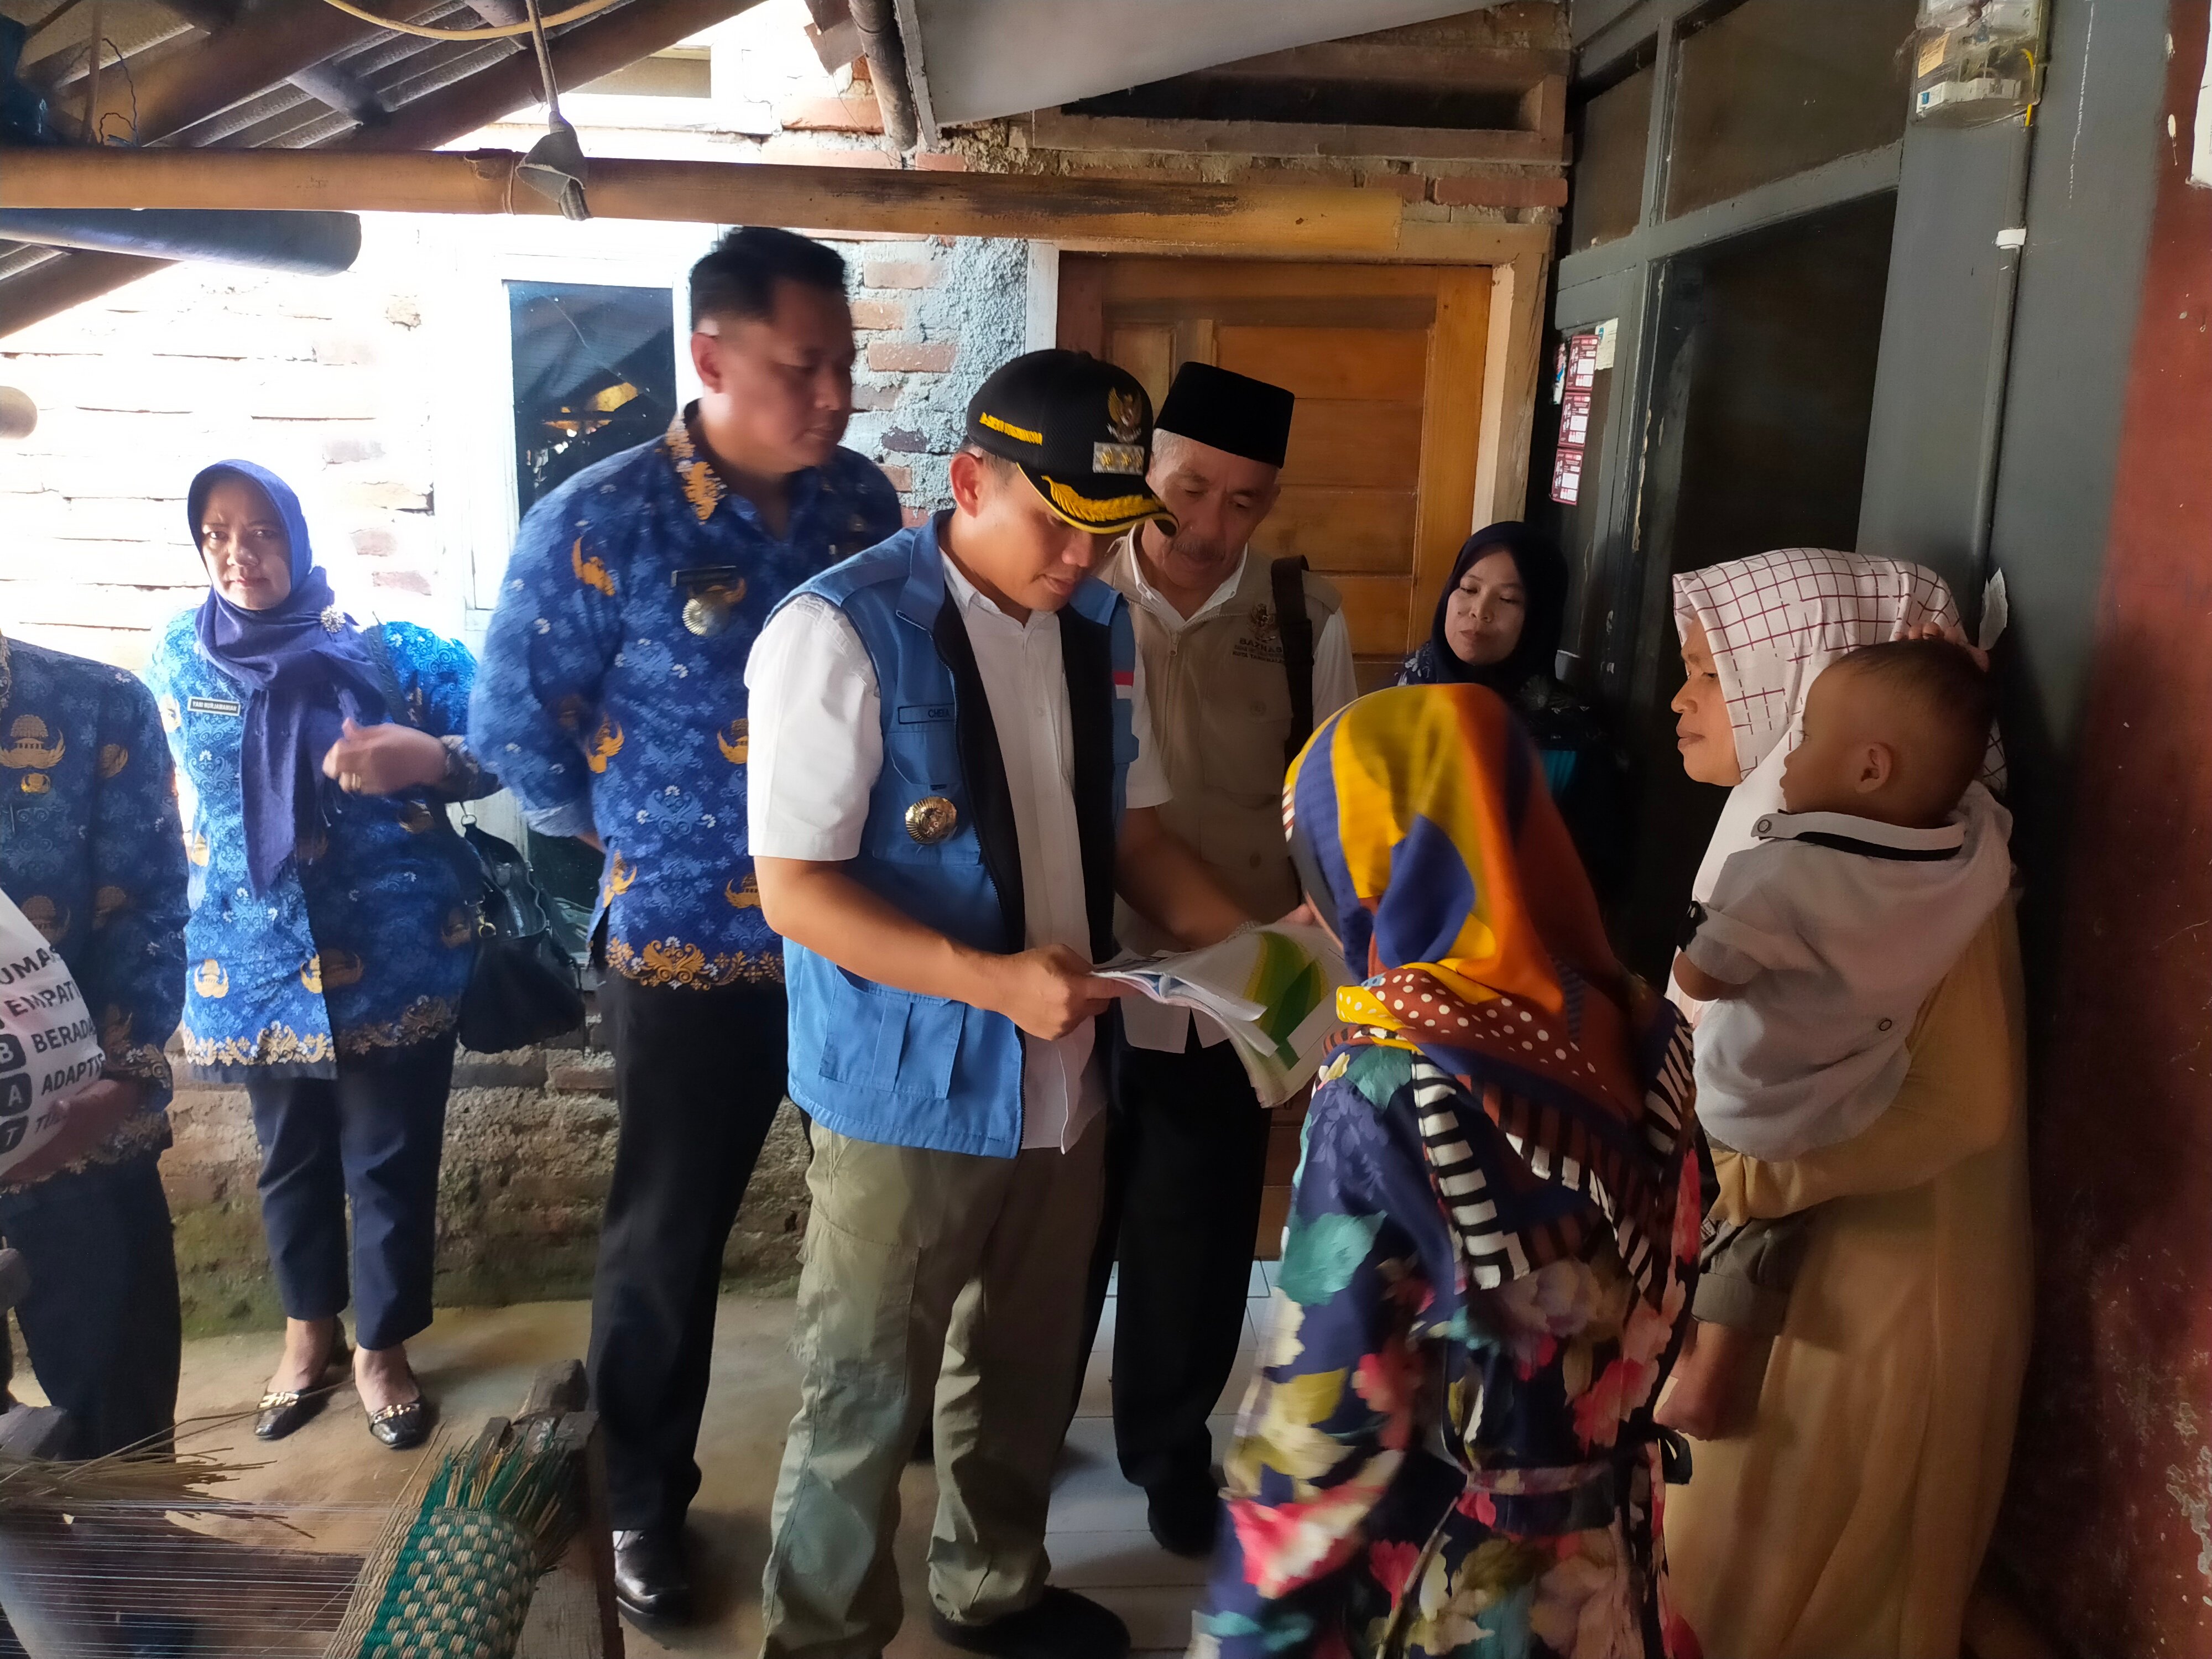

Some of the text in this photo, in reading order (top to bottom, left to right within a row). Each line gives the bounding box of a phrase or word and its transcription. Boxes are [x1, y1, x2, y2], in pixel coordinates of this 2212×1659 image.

[0, 947, 54, 984] UMA
[8, 1084, 23, 1107] A
[6, 1126, 20, 1146] T
